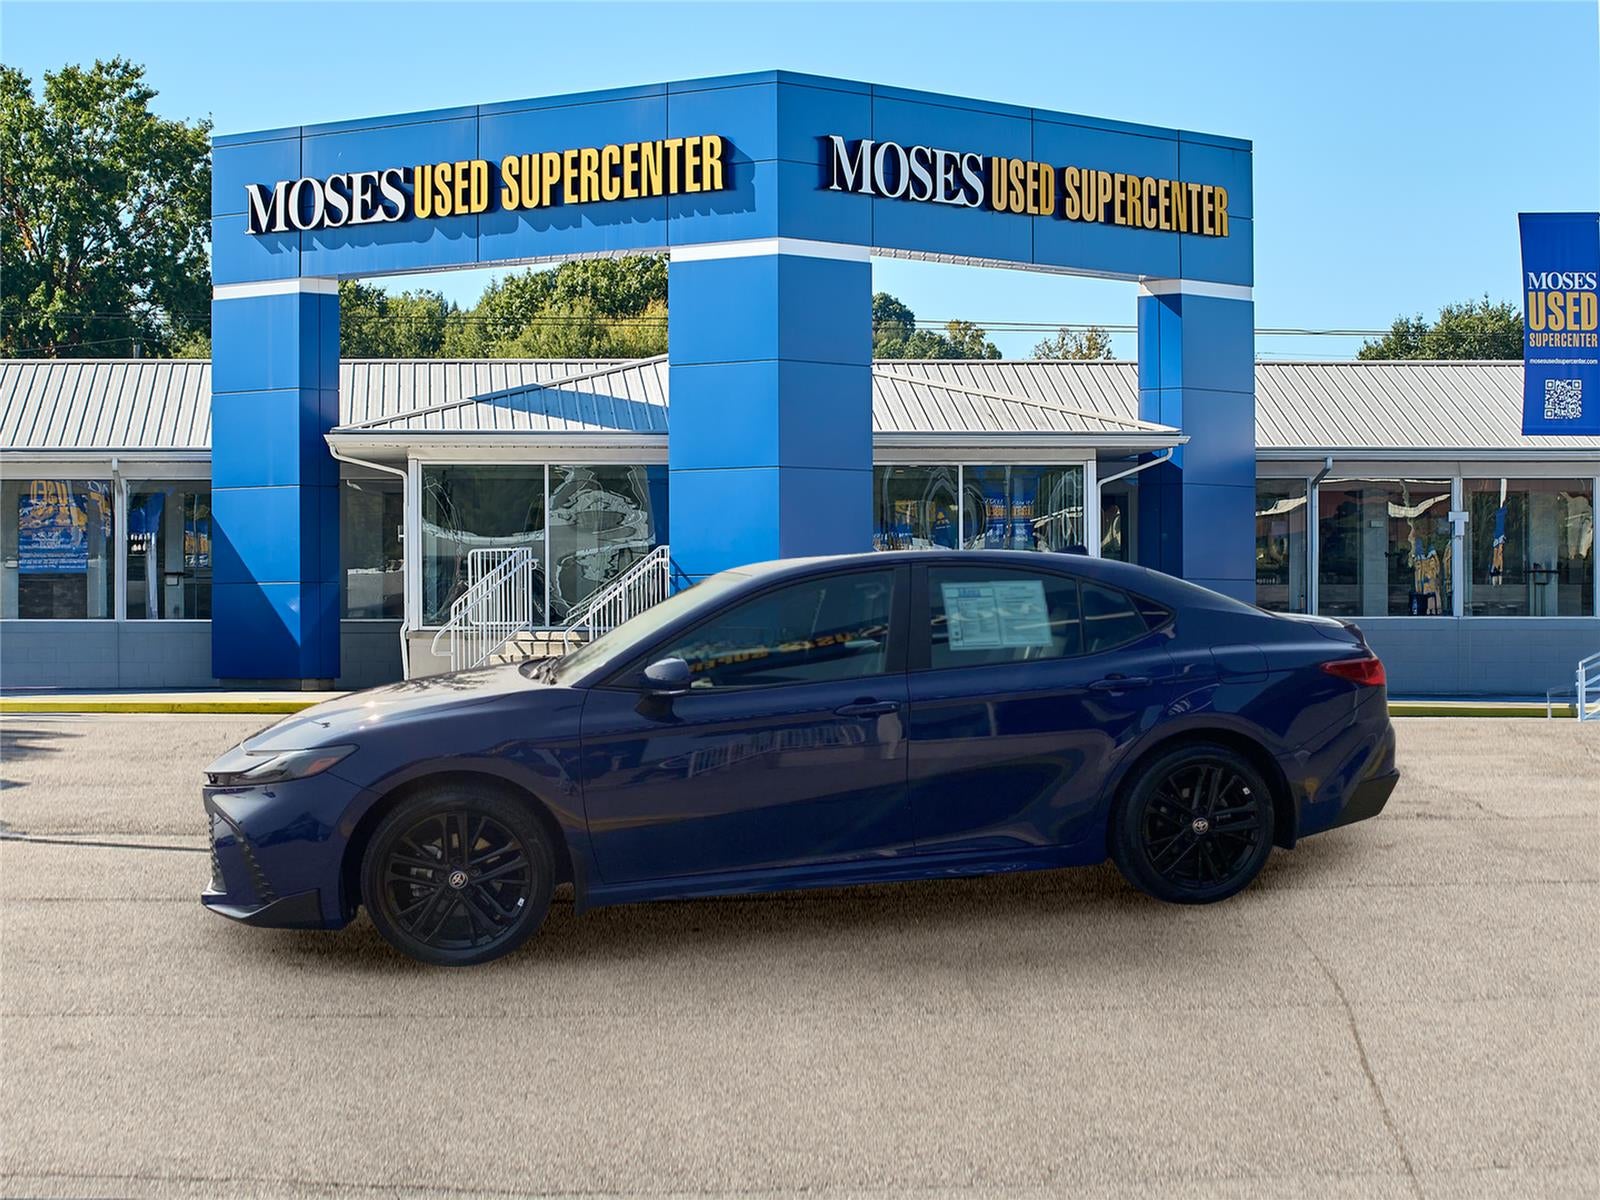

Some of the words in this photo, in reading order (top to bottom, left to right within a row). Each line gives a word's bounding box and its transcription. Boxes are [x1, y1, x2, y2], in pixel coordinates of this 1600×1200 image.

[244, 167, 408, 235] MOSES
[413, 159, 490, 220] USED
[501, 134, 725, 211] SUPERCENTER
[828, 134, 985, 208] MOSES
[991, 156, 1056, 216] USED
[1065, 165, 1230, 237] SUPERCENTER
[1528, 272, 1597, 290] MOSES
[1528, 291, 1598, 331] USED
[1529, 332, 1598, 348] SUPERCENTER
